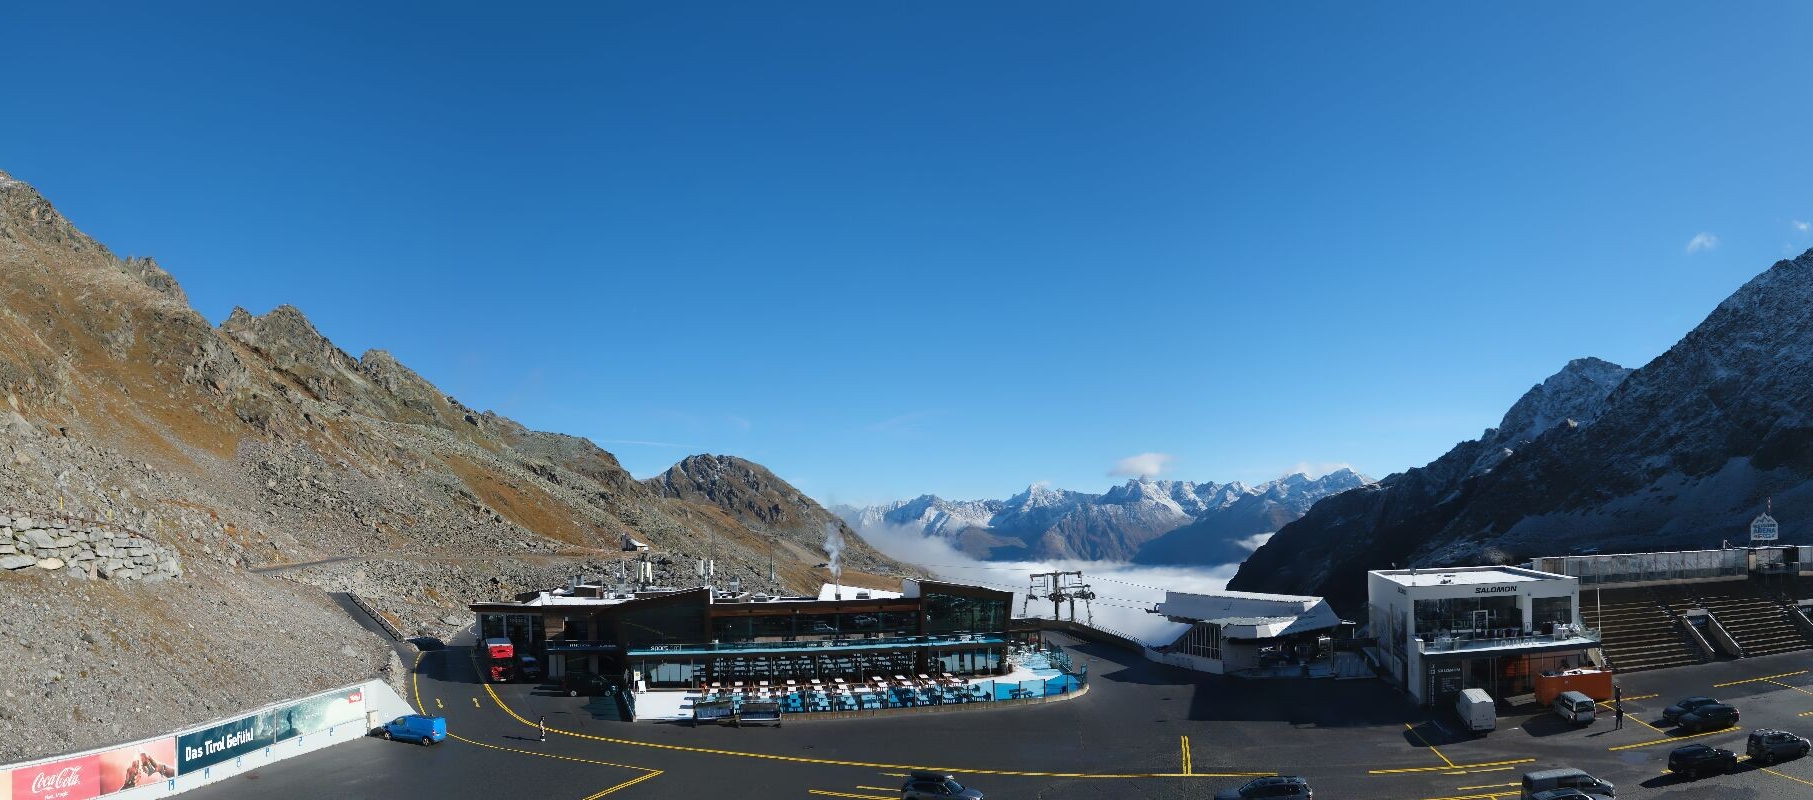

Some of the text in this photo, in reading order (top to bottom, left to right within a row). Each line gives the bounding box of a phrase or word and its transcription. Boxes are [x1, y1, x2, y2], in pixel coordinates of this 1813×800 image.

[1475, 585, 1517, 594] SALOMON
[185, 728, 254, 762] Das Tirol Gefühl
